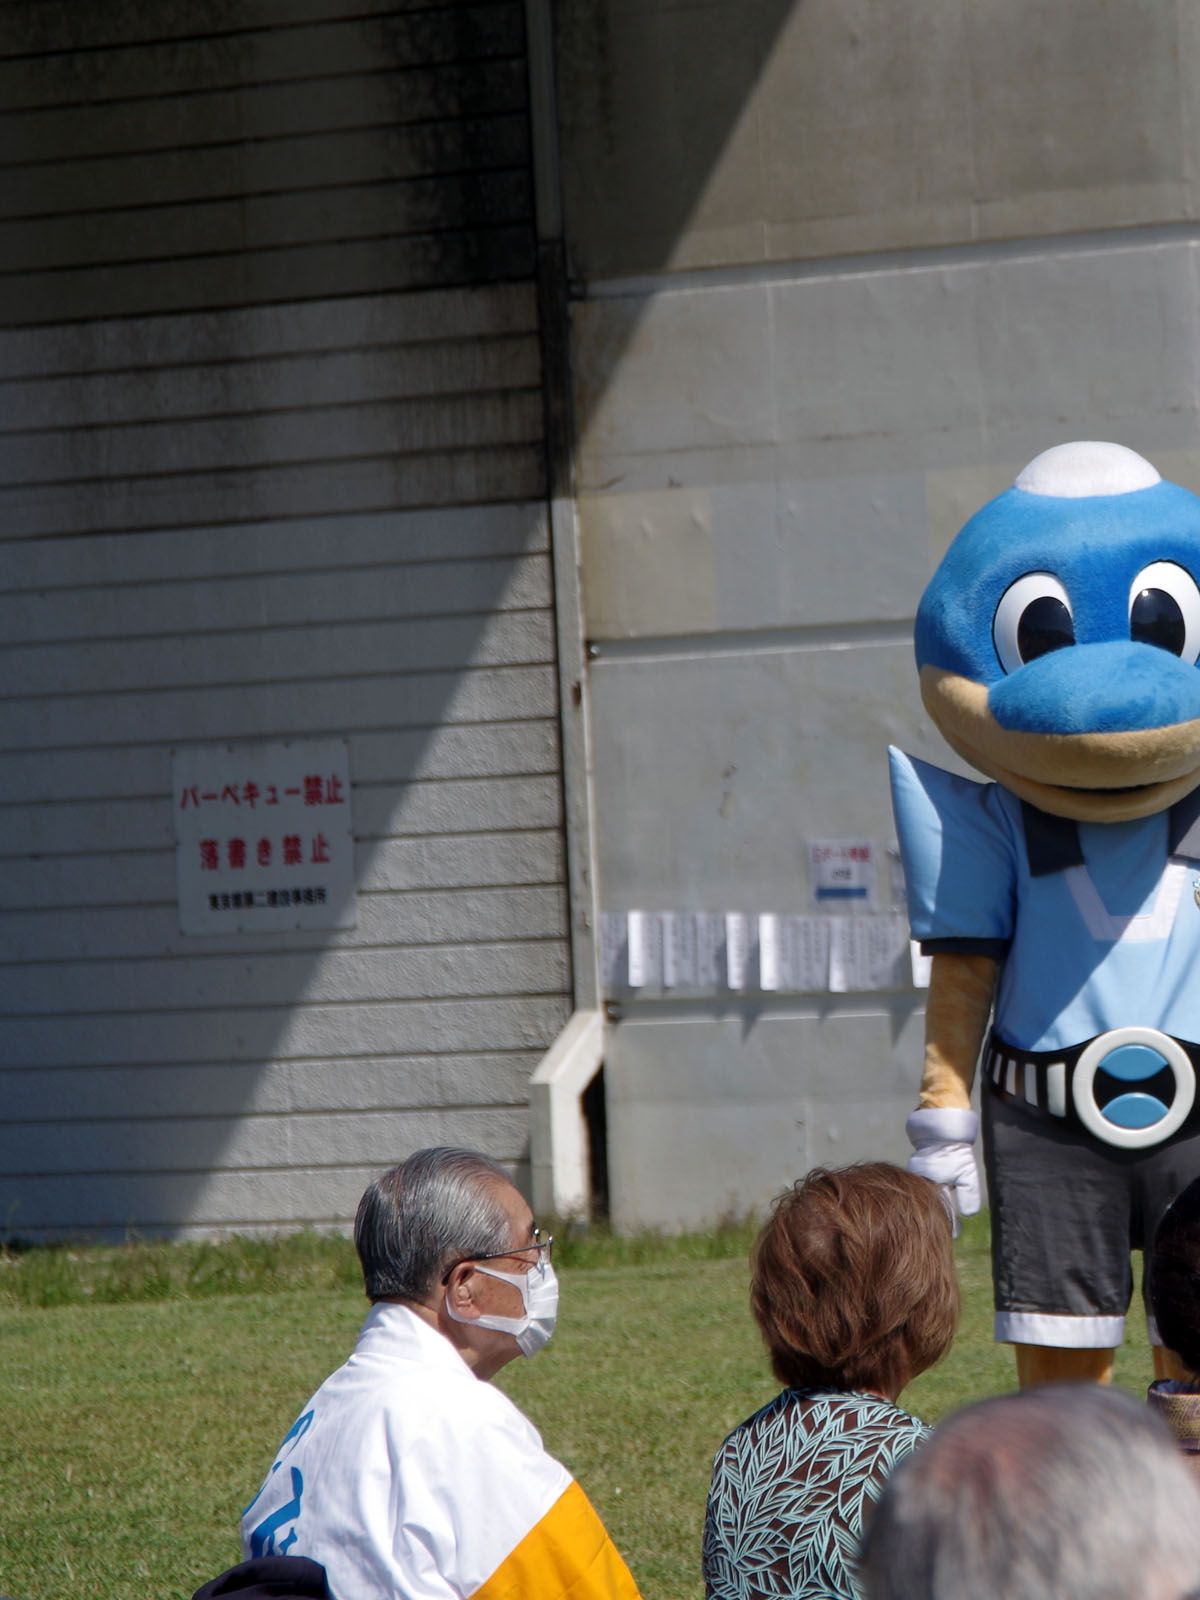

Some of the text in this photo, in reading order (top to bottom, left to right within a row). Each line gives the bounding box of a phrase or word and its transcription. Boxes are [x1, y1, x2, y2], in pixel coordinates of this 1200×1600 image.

[180, 773, 345, 810] バーベキュー禁止
[199, 833, 331, 871] 落書き禁止
